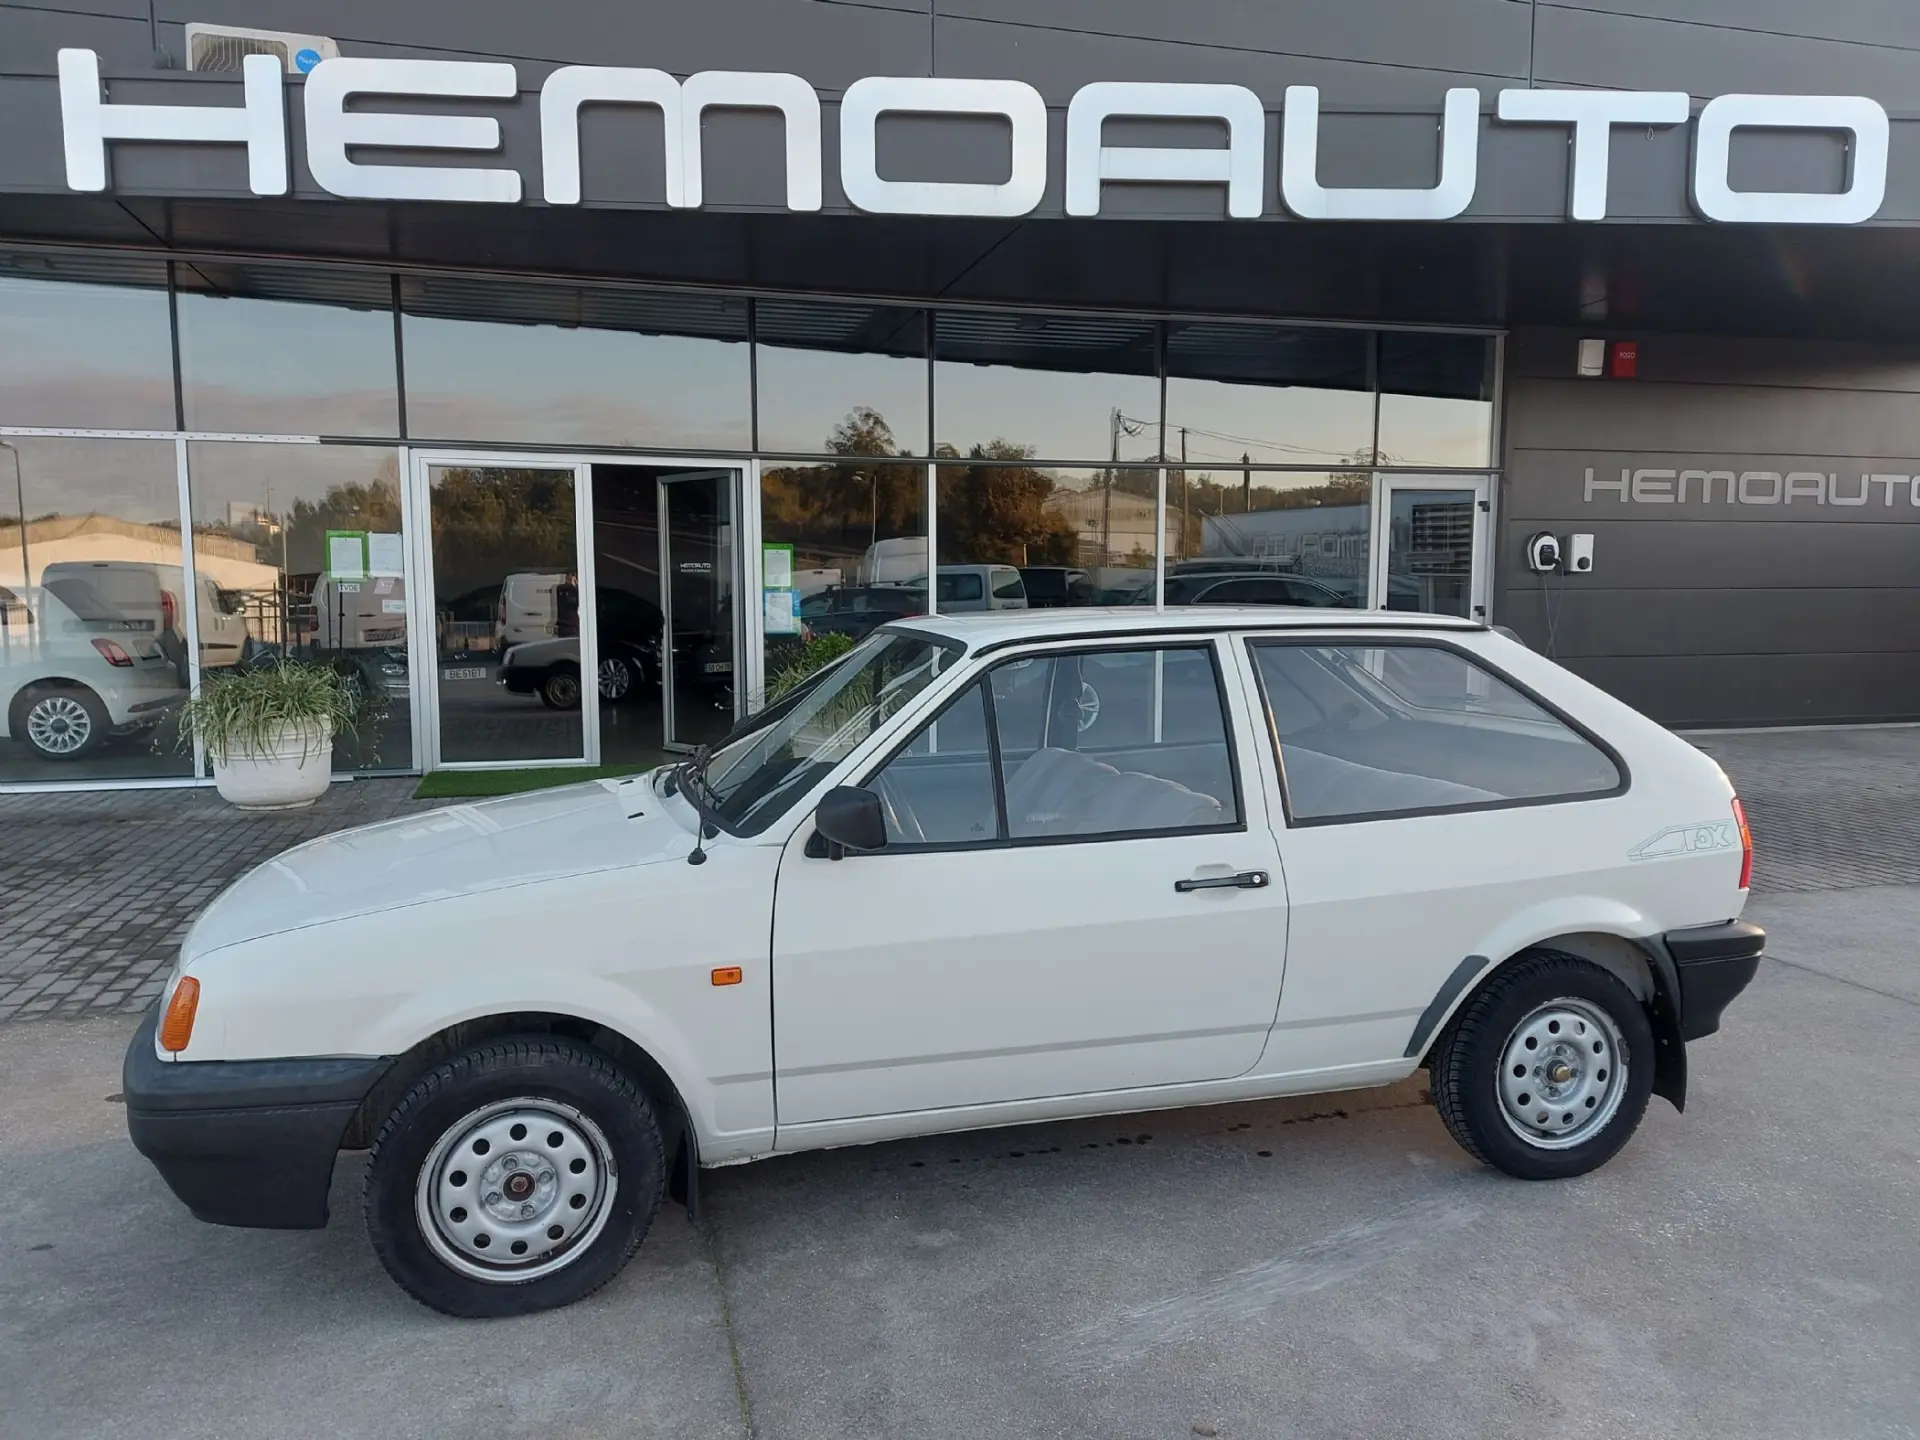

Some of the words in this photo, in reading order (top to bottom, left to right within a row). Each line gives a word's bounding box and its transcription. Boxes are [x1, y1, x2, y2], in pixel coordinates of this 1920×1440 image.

[58, 48, 1889, 224] HEMOAUTO
[1583, 467, 1920, 507] HEMOAUT
[1683, 824, 1732, 851] FOX
